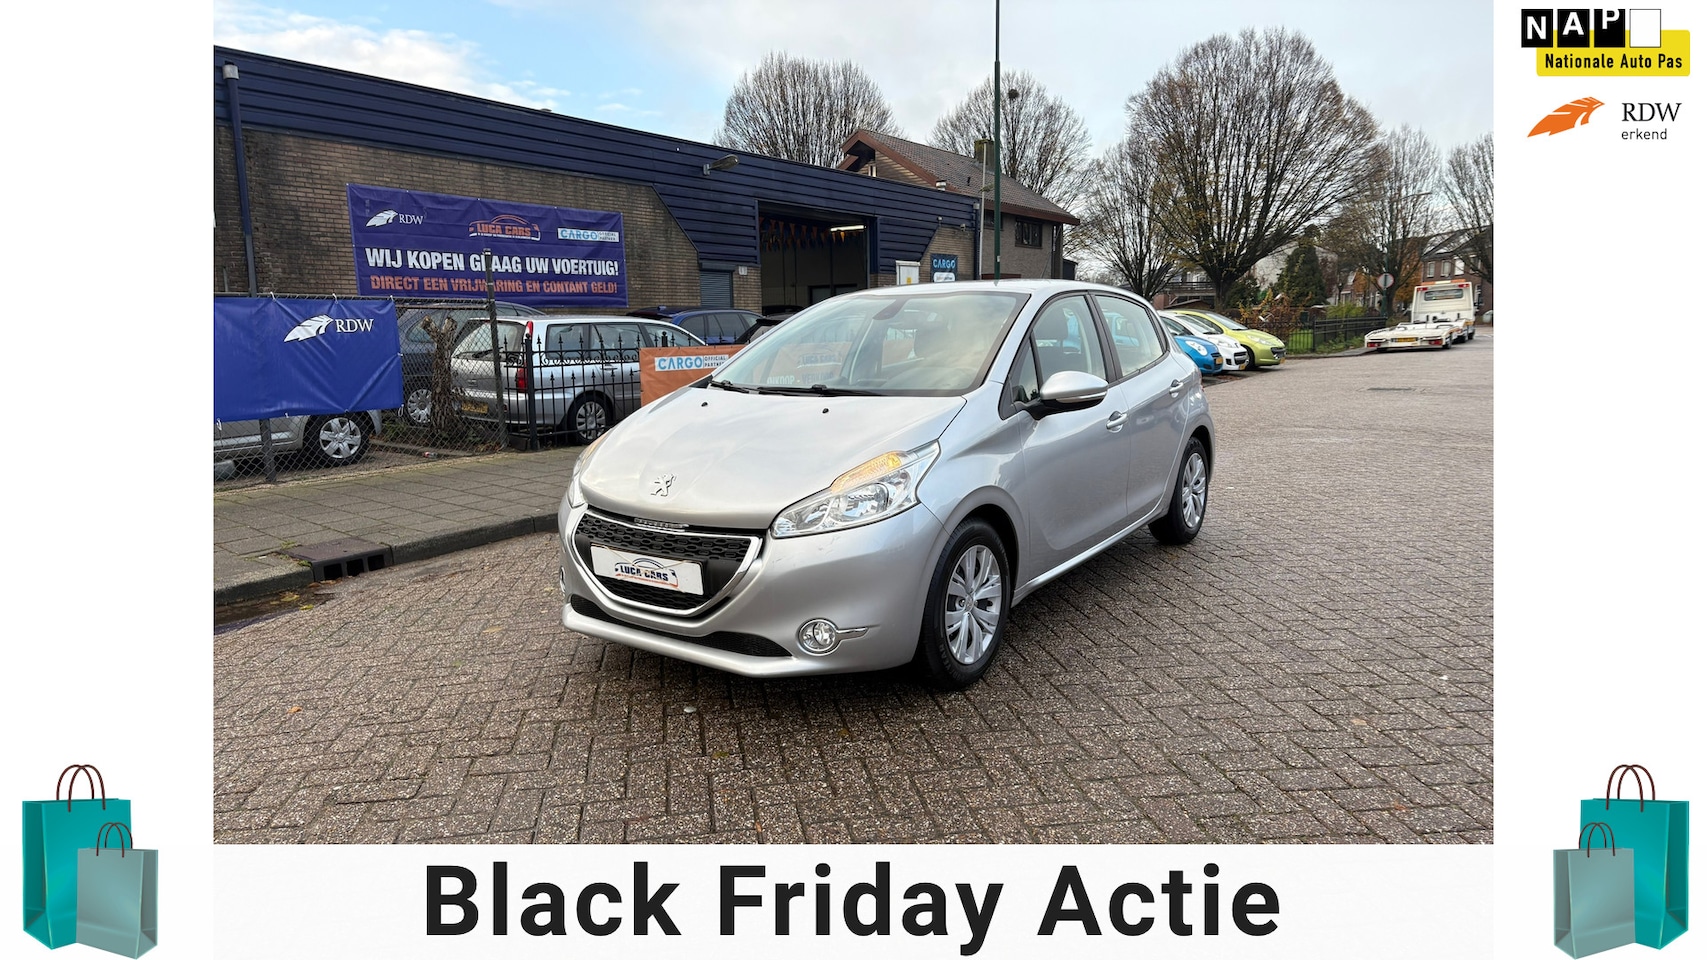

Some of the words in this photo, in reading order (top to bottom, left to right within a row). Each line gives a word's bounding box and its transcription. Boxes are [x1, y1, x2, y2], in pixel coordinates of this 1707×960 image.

[399, 213, 424, 225] RDW
[477, 223, 503, 234] LUCA
[504, 226, 531, 236] CARS
[560, 229, 598, 240] CARGO
[365, 248, 403, 268] WIJ
[406, 250, 465, 271] KOPEN
[525, 257, 549, 274] UW
[552, 258, 619, 276] VOERTUIG!
[932, 258, 956, 269] CARGO
[370, 275, 420, 290] DIRECT
[423, 277, 449, 291] EEN
[450, 277, 524, 292] VRIJWRING
[526, 280, 540, 293] EN
[543, 280, 588, 294] CONTANT
[591, 281, 618, 294] GELD!
[335, 319, 374, 333] RDW
[658, 356, 703, 370] CARGO
[620, 565, 642, 577] LUCA
[644, 570, 668, 581] CARS
